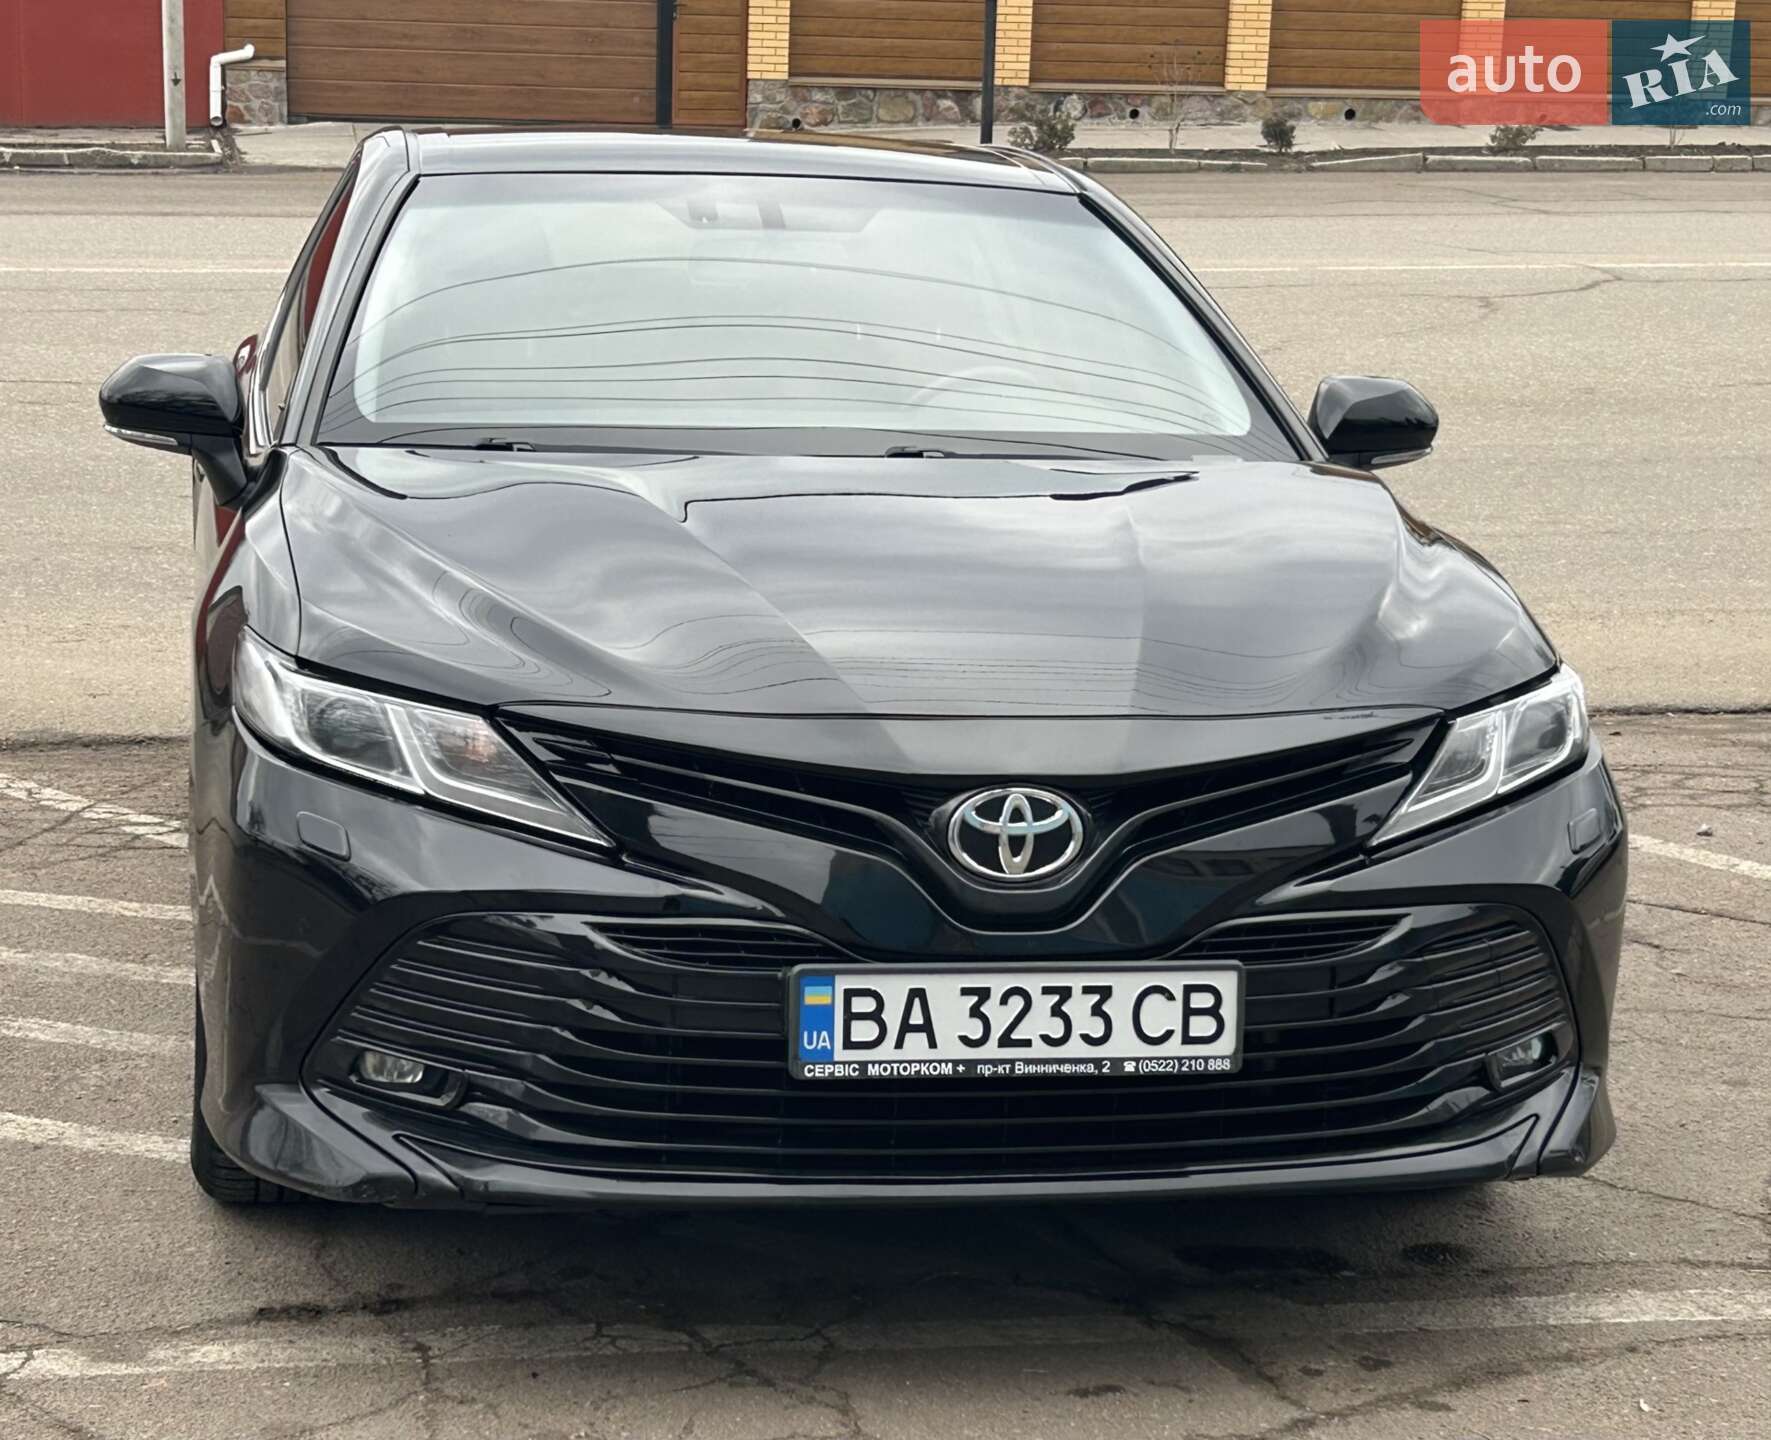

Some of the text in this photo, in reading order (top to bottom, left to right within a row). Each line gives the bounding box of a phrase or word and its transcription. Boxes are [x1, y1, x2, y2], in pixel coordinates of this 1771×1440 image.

[842, 983, 1226, 1051] BA 3233 CB
[803, 1030, 832, 1050] UA
[804, 1063, 860, 1077] СЕРВІС
[867, 1062, 953, 1076] МОТОРКОМ
[977, 1062, 1011, 1077] пр-кт
[1101, 1060, 1111, 1073] 2
[1138, 1058, 1178, 1075] (0522)
[1181, 1058, 1205, 1071] 210
